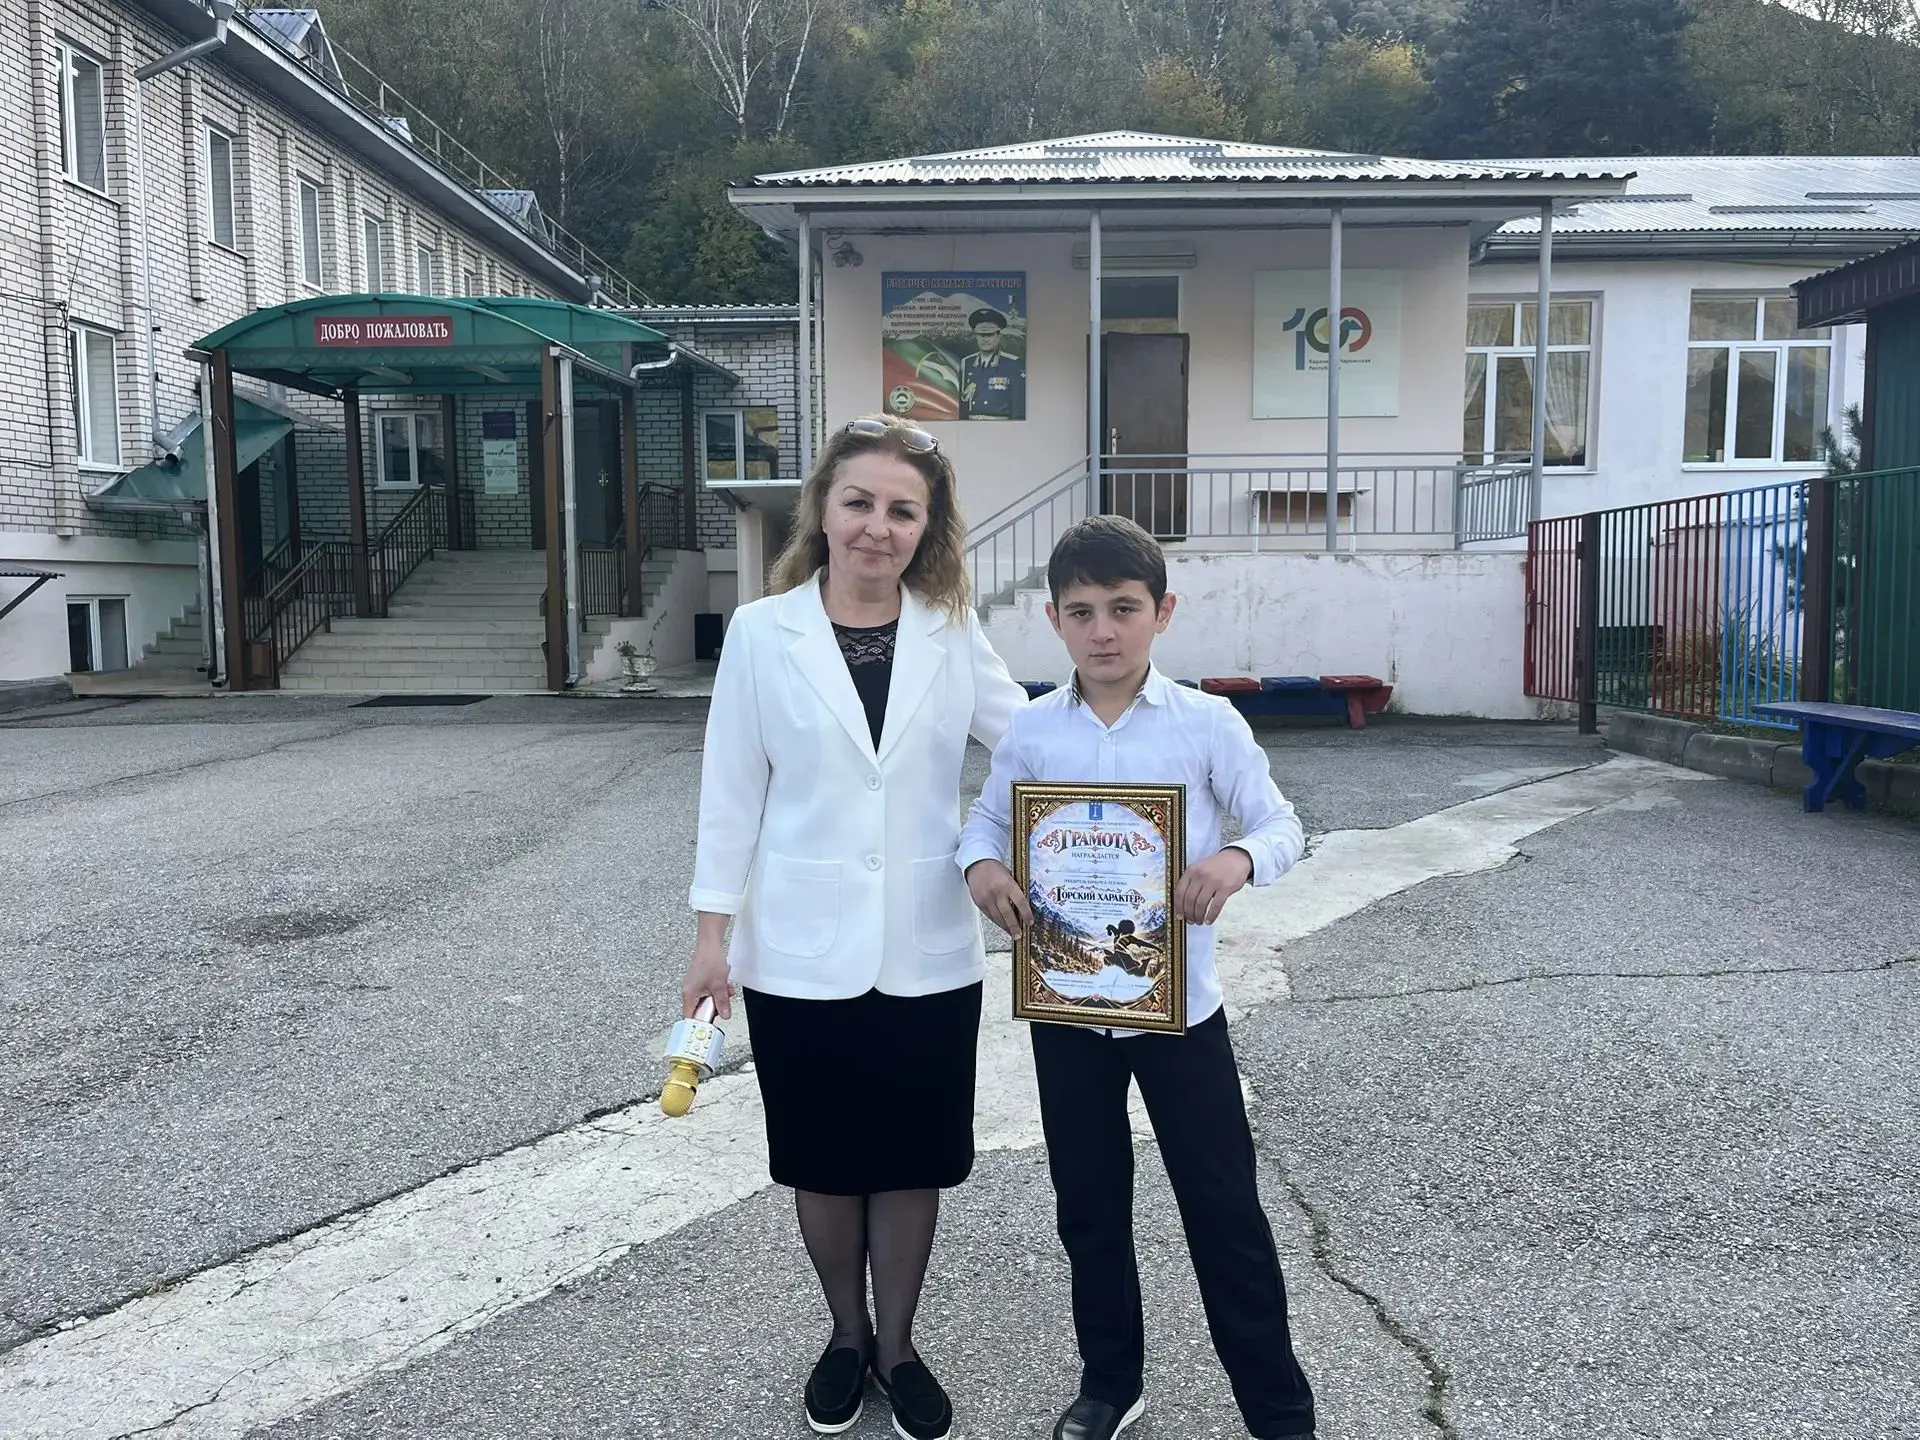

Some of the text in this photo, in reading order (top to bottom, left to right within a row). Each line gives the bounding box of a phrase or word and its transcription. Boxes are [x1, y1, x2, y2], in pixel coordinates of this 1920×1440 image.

[320, 322, 449, 341] ДОБРО ПОЖАЛОВАТЬ
[1055, 829, 1136, 857] ГРАМОТА
[1071, 852, 1120, 860] НАГРАЖДАЕТСЯ
[1055, 885, 1096, 902] ГОРСКИЙ
[1097, 892, 1142, 904] ХАРАКТЕР
